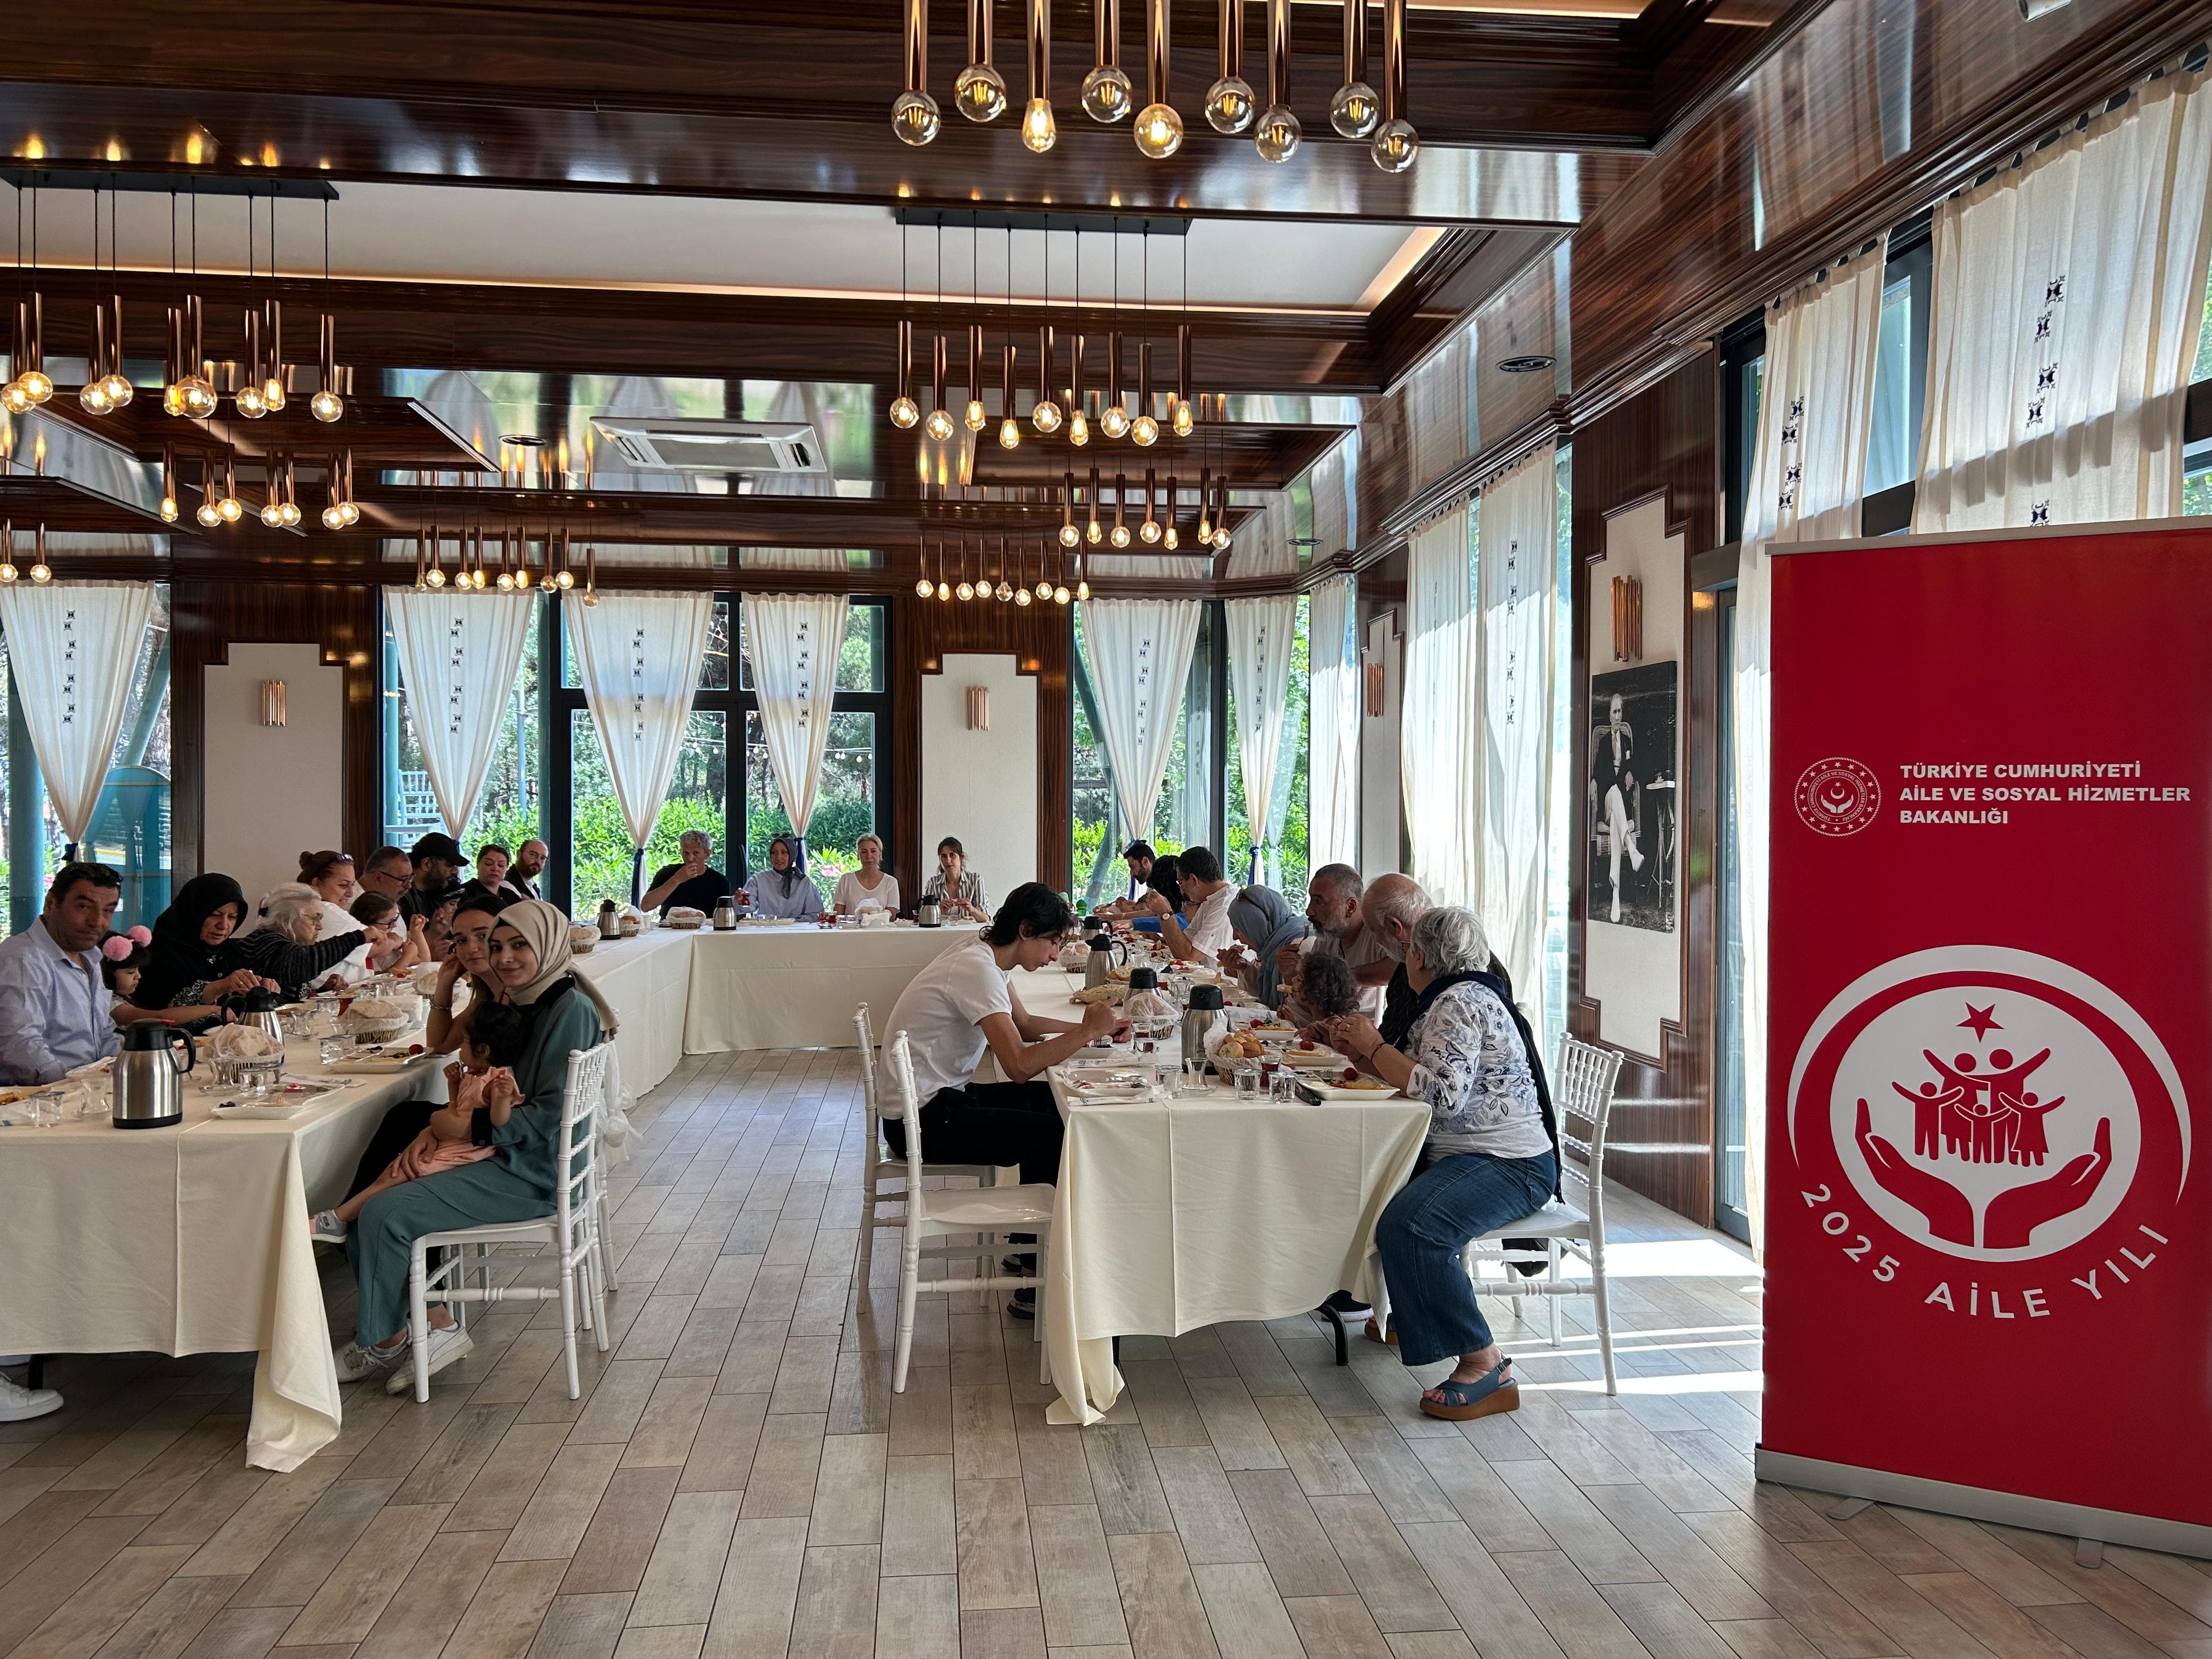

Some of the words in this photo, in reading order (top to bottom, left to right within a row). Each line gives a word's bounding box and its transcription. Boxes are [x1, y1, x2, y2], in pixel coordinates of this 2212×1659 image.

[1900, 760, 1988, 778] TÜRKİYE
[1994, 760, 2141, 778] CUMHURİYETİ
[1899, 784, 1943, 801] AİLE
[1949, 787, 1976, 801] VE
[1982, 787, 2062, 801] SOSYAL
[2068, 784, 2191, 801] HİZMETLER
[1900, 807, 2008, 824] BAKANLIĞI
[1801, 1183, 1900, 1282] 2025
[1924, 1282, 2050, 1319] AİLE
[2070, 1224, 2169, 1300] YILI
